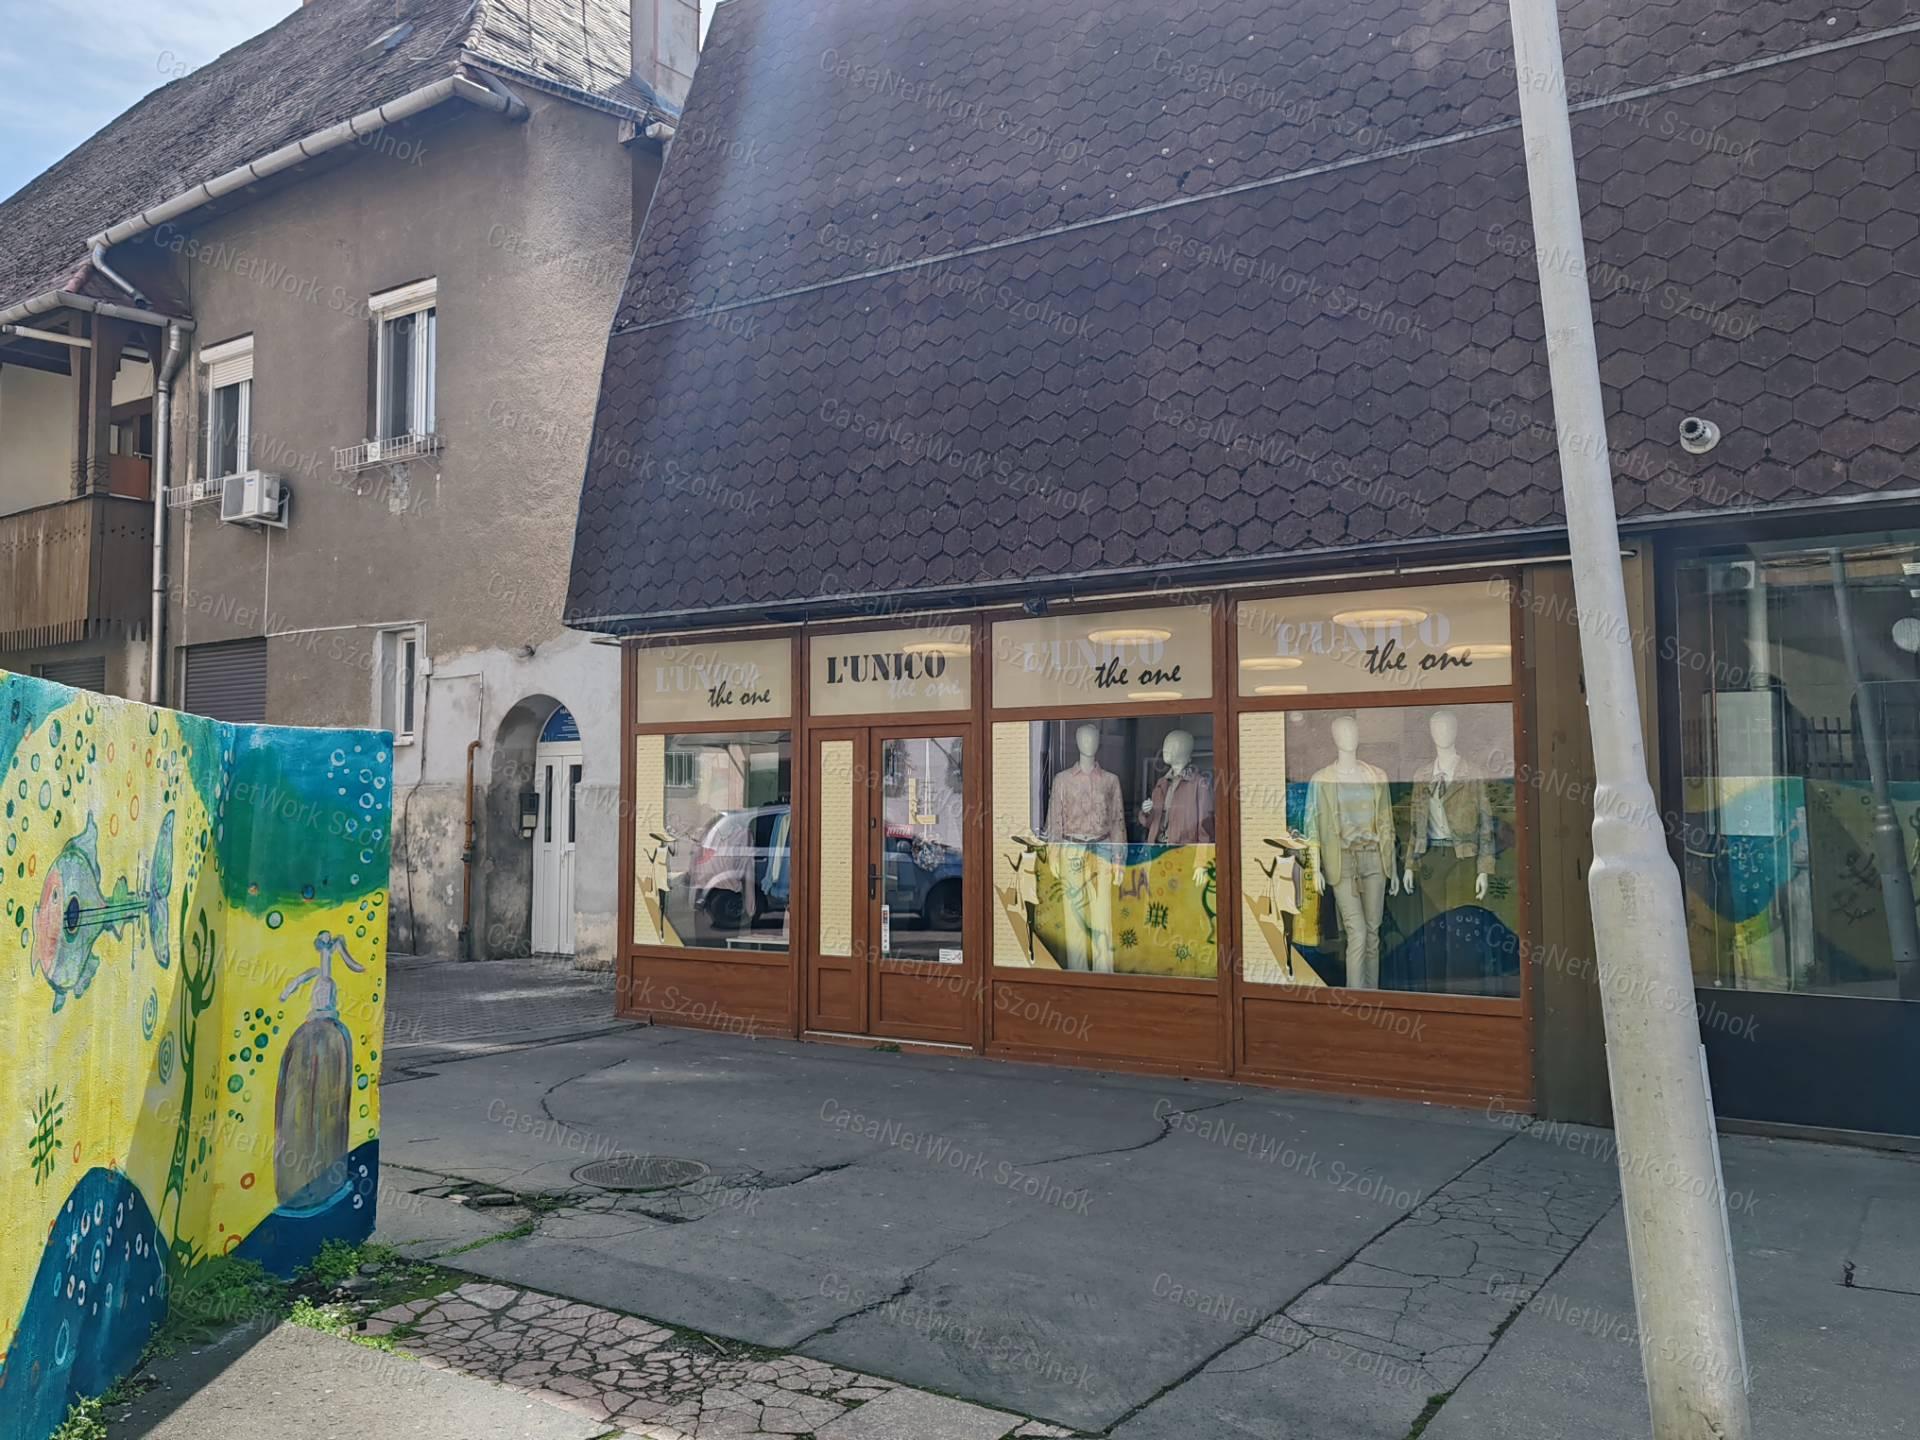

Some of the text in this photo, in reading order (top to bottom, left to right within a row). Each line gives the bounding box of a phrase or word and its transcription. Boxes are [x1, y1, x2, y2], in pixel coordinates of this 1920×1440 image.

[827, 650, 946, 684] L'UNICO
[1023, 637, 1168, 673] L'UNICO
[1095, 656, 1182, 688] the one
[1365, 639, 1473, 674] the one
[708, 681, 771, 708] the one
